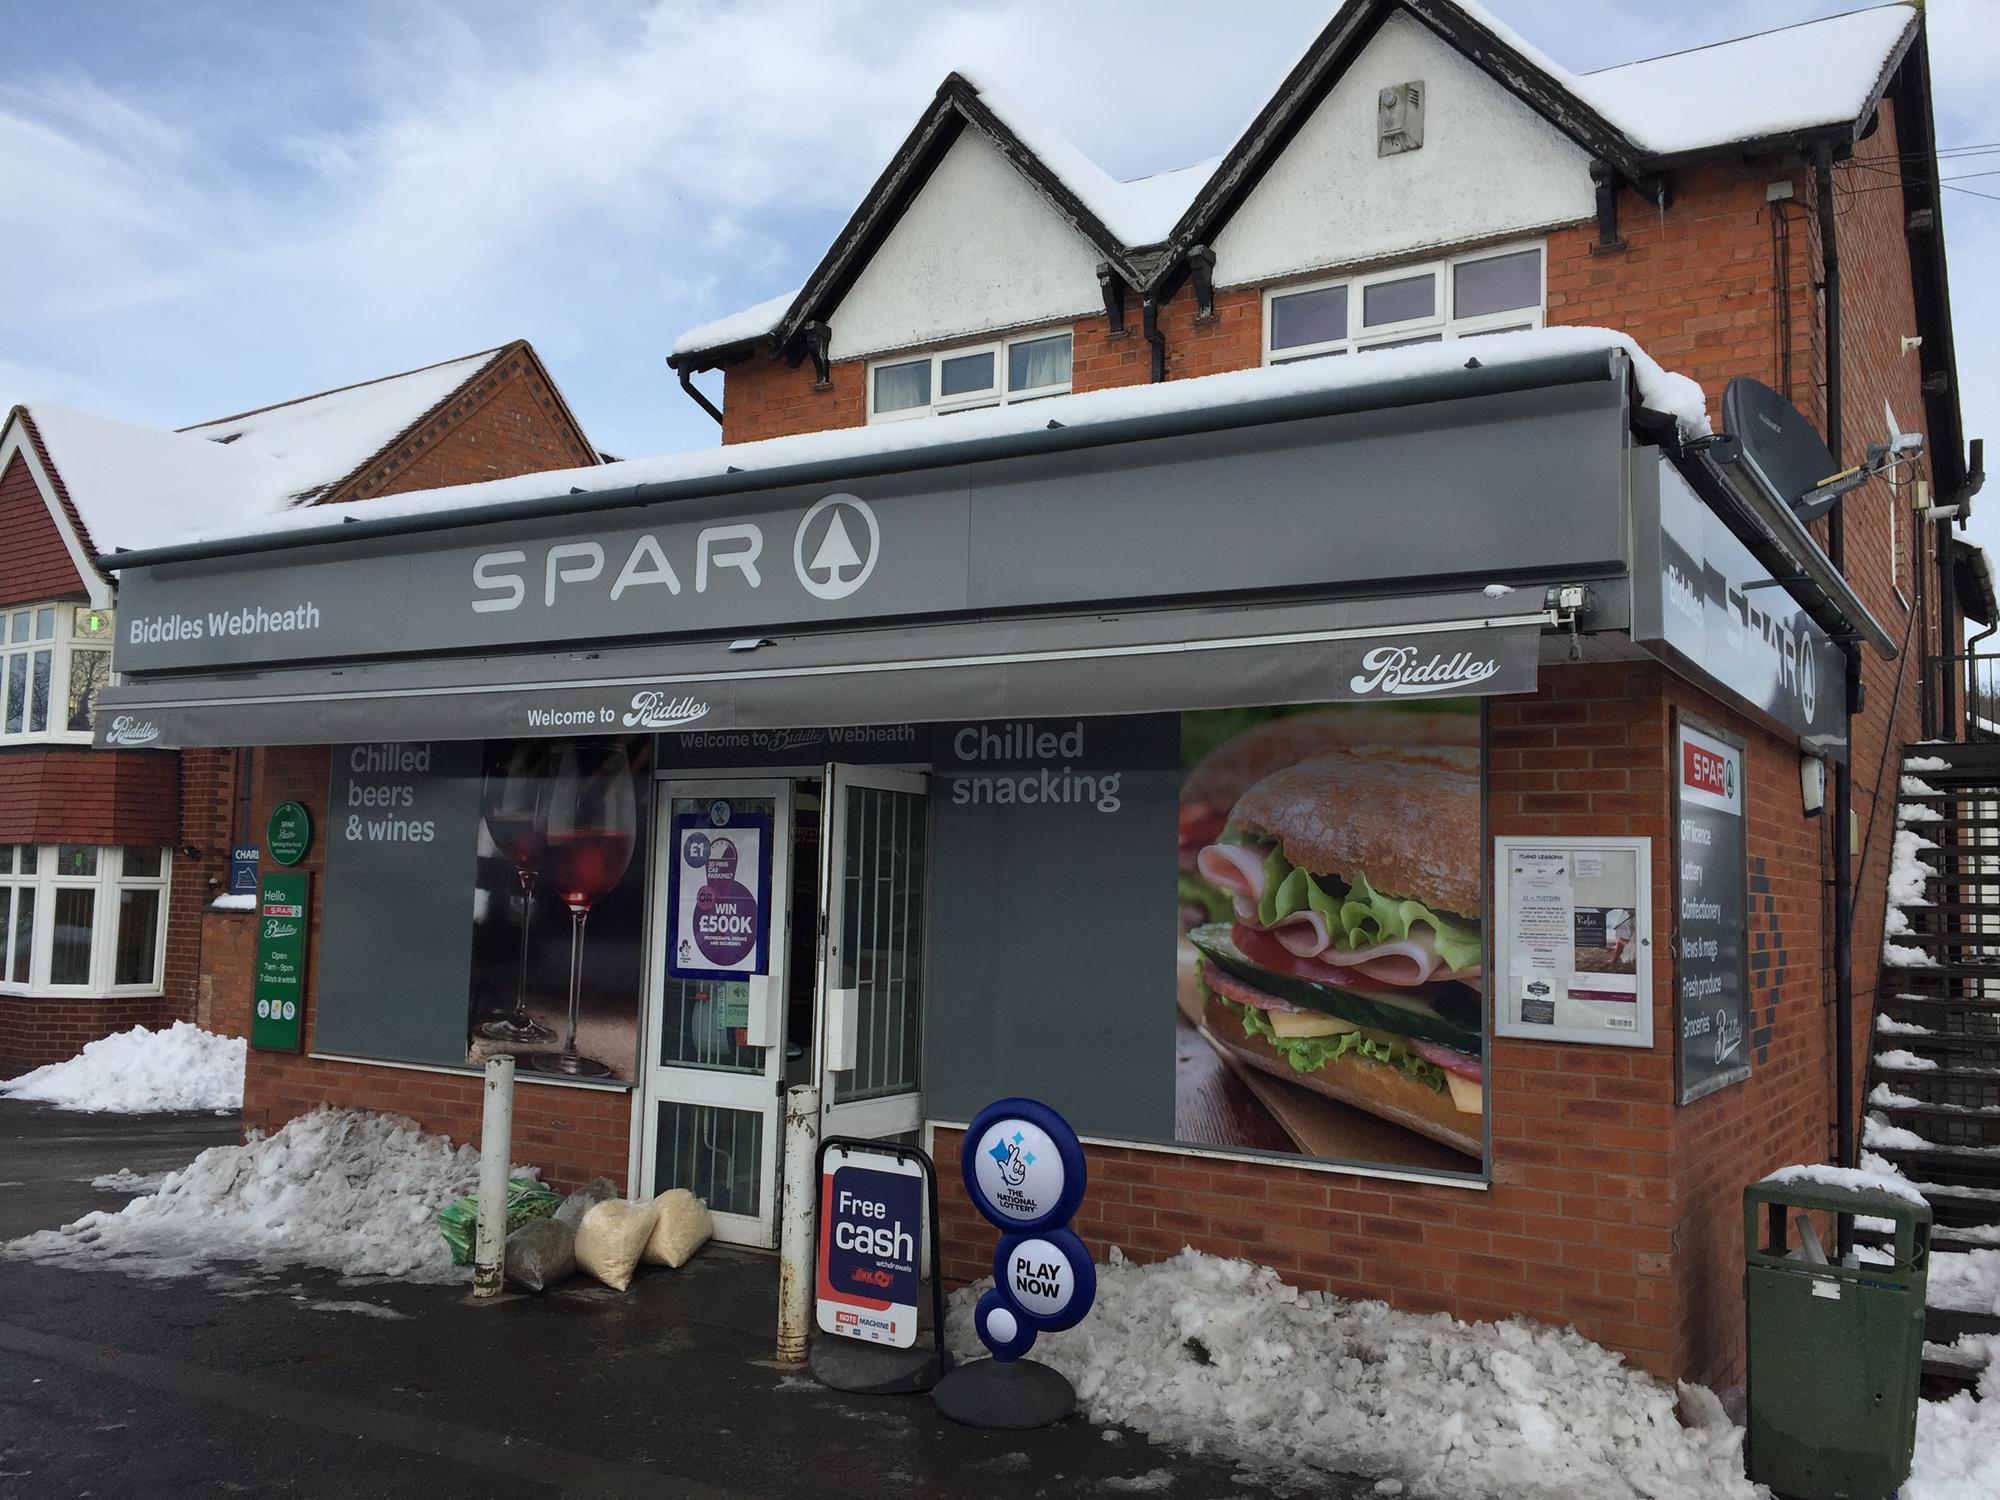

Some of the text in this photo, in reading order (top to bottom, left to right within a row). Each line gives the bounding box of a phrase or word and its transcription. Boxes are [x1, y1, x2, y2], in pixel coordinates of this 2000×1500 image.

[472, 523, 762, 613] SPAR
[129, 602, 320, 645] Biddles Webheath
[1349, 646, 1501, 695] Biddles
[527, 691, 711, 728] Welcome to Biddles
[105, 715, 160, 745] Biddles
[680, 724, 915, 752] Welcome to Biddles Webheath
[953, 723, 1085, 763] Chilled
[350, 744, 431, 773] Chilled
[1693, 752, 1725, 788] SPAR
[348, 779, 414, 807] beers
[952, 767, 1122, 813] snacking
[280, 821, 296, 829] SPAR
[345, 812, 435, 842] & wines
[689, 842, 705, 857] £1
[1681, 858, 1704, 885] Lottery
[264, 890, 286, 901] Hello
[700, 892, 713, 903] OR
[715, 903, 737, 915] WIN
[270, 906, 293, 915] SPAR
[1681, 897, 1721, 924] Confectionery
[699, 915, 753, 934] £500K
[271, 951, 288, 960] Open
[1682, 937, 1698, 959] News
[1703, 938, 1718, 962] mags
[264, 974, 277, 983] days
[281, 976, 296, 984] week
[1682, 972, 1721, 1000] Fresh produce
[1683, 1010, 1710, 1038] Groceries
[839, 1190, 886, 1219] Free
[996, 1192, 1038, 1207] NATIONAL
[999, 1200, 1036, 1213] LOTTERY
[1007, 1188, 1024, 1198] THE
[835, 1221, 913, 1262] cash
[876, 1260, 912, 1273] withdrawals
[1016, 1257, 1061, 1281] PLAY
[1016, 1275, 1060, 1299] NOW
[839, 1312, 889, 1330] NOTE MACHINE
